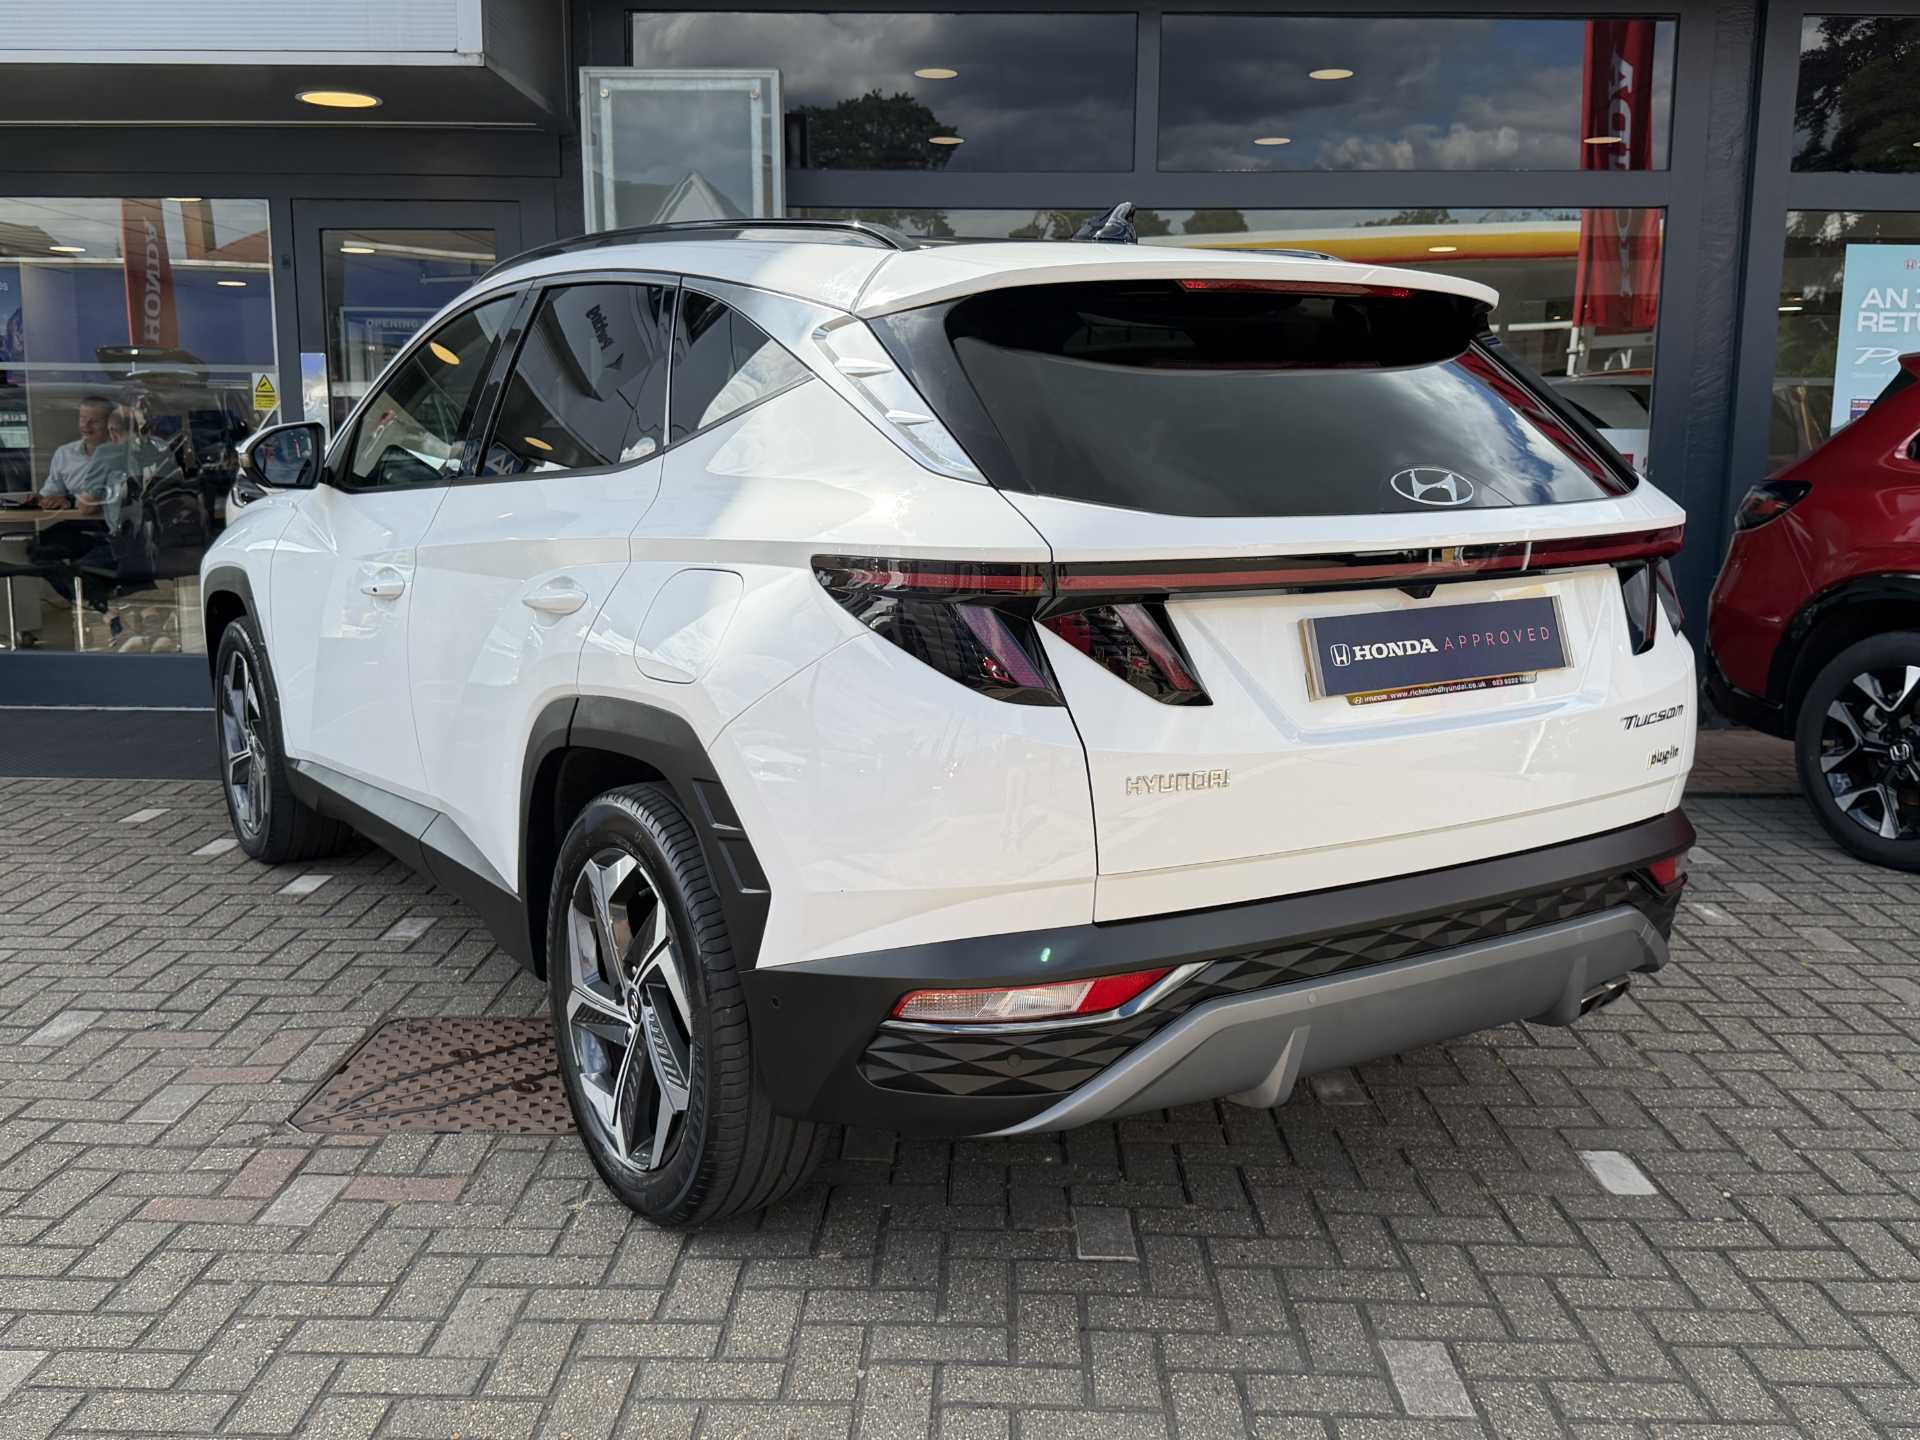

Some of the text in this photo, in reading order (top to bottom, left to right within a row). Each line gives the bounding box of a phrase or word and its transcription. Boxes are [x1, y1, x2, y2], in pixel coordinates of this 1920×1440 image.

[1861, 287, 1909, 309] AN
[1352, 626, 1551, 662] HONDA APPROVED
[1126, 769, 1230, 797] HYUNDAI
